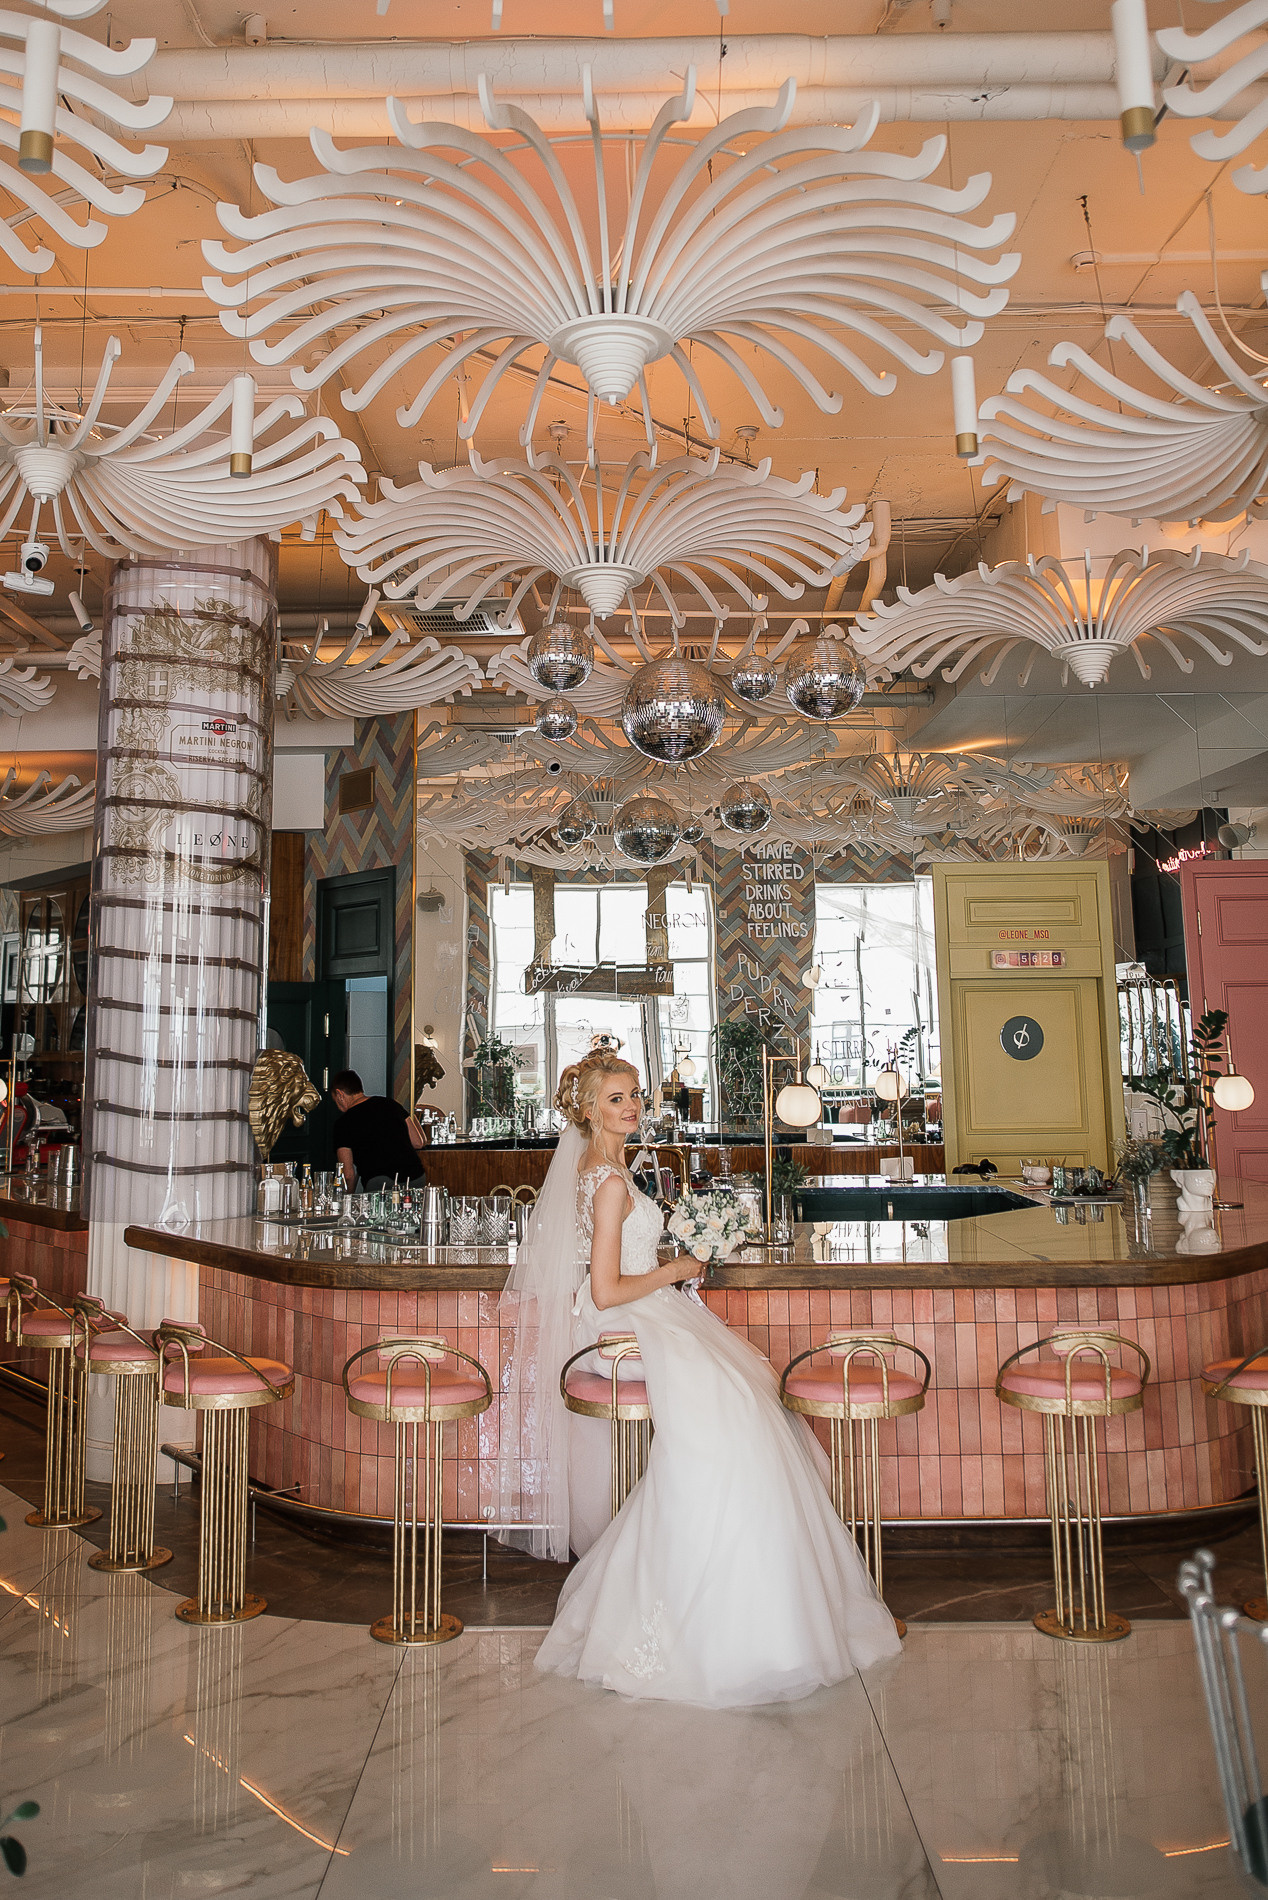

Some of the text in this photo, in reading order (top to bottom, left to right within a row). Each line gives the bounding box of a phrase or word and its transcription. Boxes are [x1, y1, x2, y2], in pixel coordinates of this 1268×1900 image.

[203, 723, 236, 732] MARTINI
[179, 736, 254, 751] MARTINI NEGRONI
[756, 843, 793, 860] HAVE
[742, 863, 805, 880] STIRRED
[745, 884, 792, 901] DRINKS
[747, 903, 793, 920] ABOUT
[747, 922, 809, 939] FEELINGS
[1021, 954, 1059, 964] 5629
[823, 1064, 851, 1084] NOT
